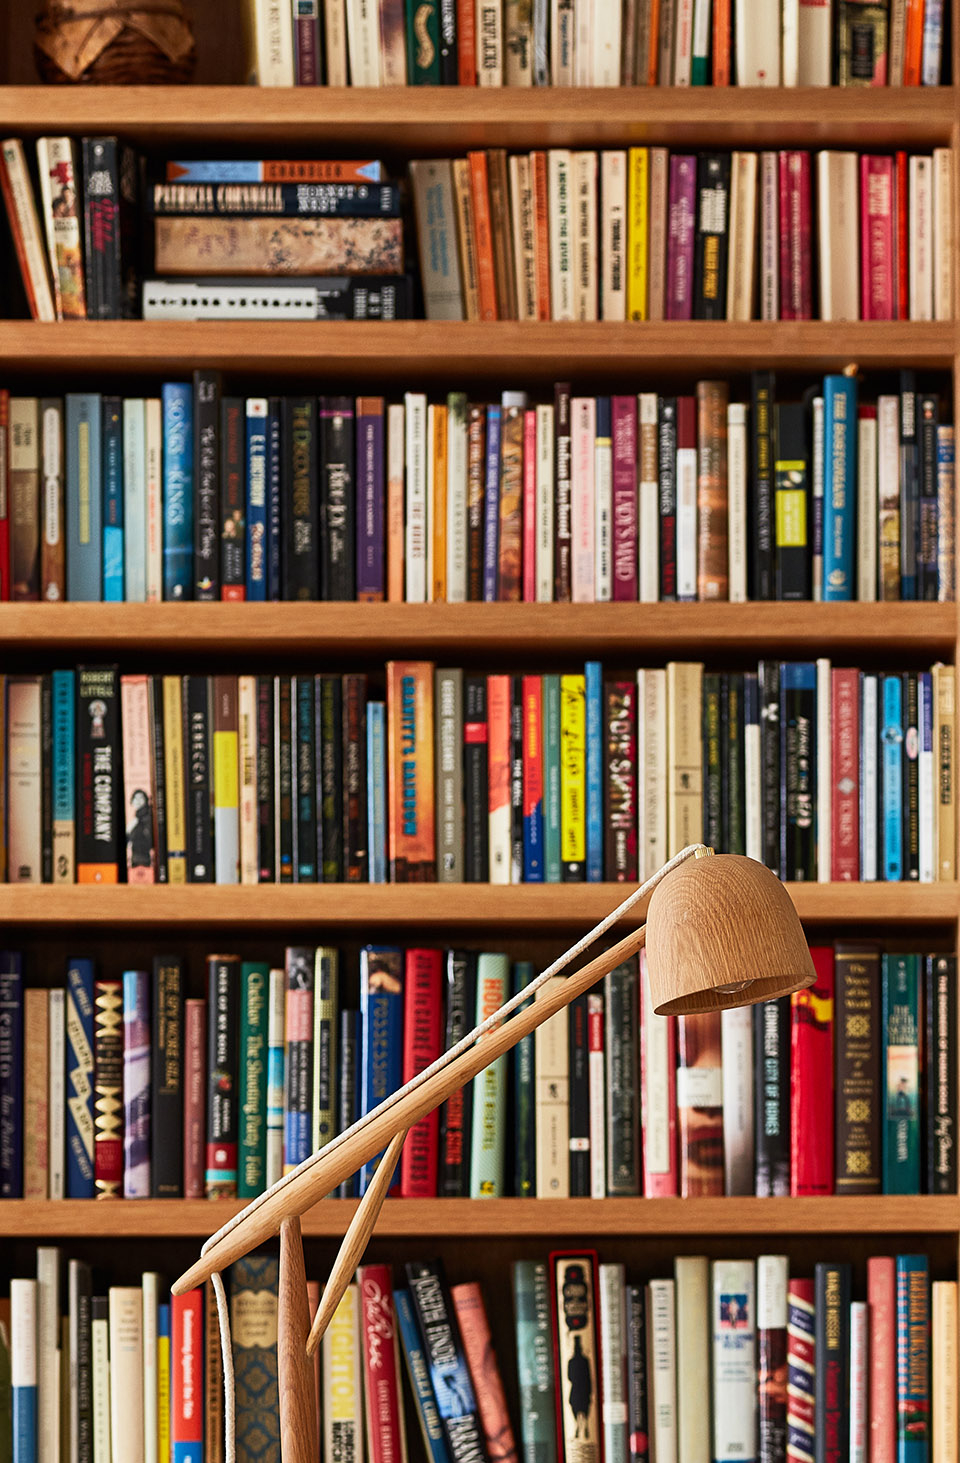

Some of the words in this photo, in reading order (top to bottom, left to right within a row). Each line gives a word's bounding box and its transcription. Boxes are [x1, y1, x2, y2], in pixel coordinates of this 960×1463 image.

[167, 398, 184, 455] SONGS
[293, 403, 312, 429] THE
[167, 471, 184, 526] KINGS
[402, 677, 416, 755] GRAVITY'S
[94, 746, 111, 773] THE
[192, 712, 204, 784] REBECCA
[94, 775, 112, 843] COMPANY
[402, 761, 416, 836] RAINBOW
[246, 972, 263, 1027] Chekhov
[247, 1036, 263, 1058] The
[765, 1084, 779, 1098] OF
[243, 1115, 262, 1147] Party
[765, 1100, 779, 1136] BONES
[446, 1131, 463, 1165] SONG
[245, 1156, 262, 1186] Folio
[534, 1264, 548, 1330] WILLIAM
[534, 1336, 549, 1392] GIBSON
[183, 1400, 193, 1419] Tide
